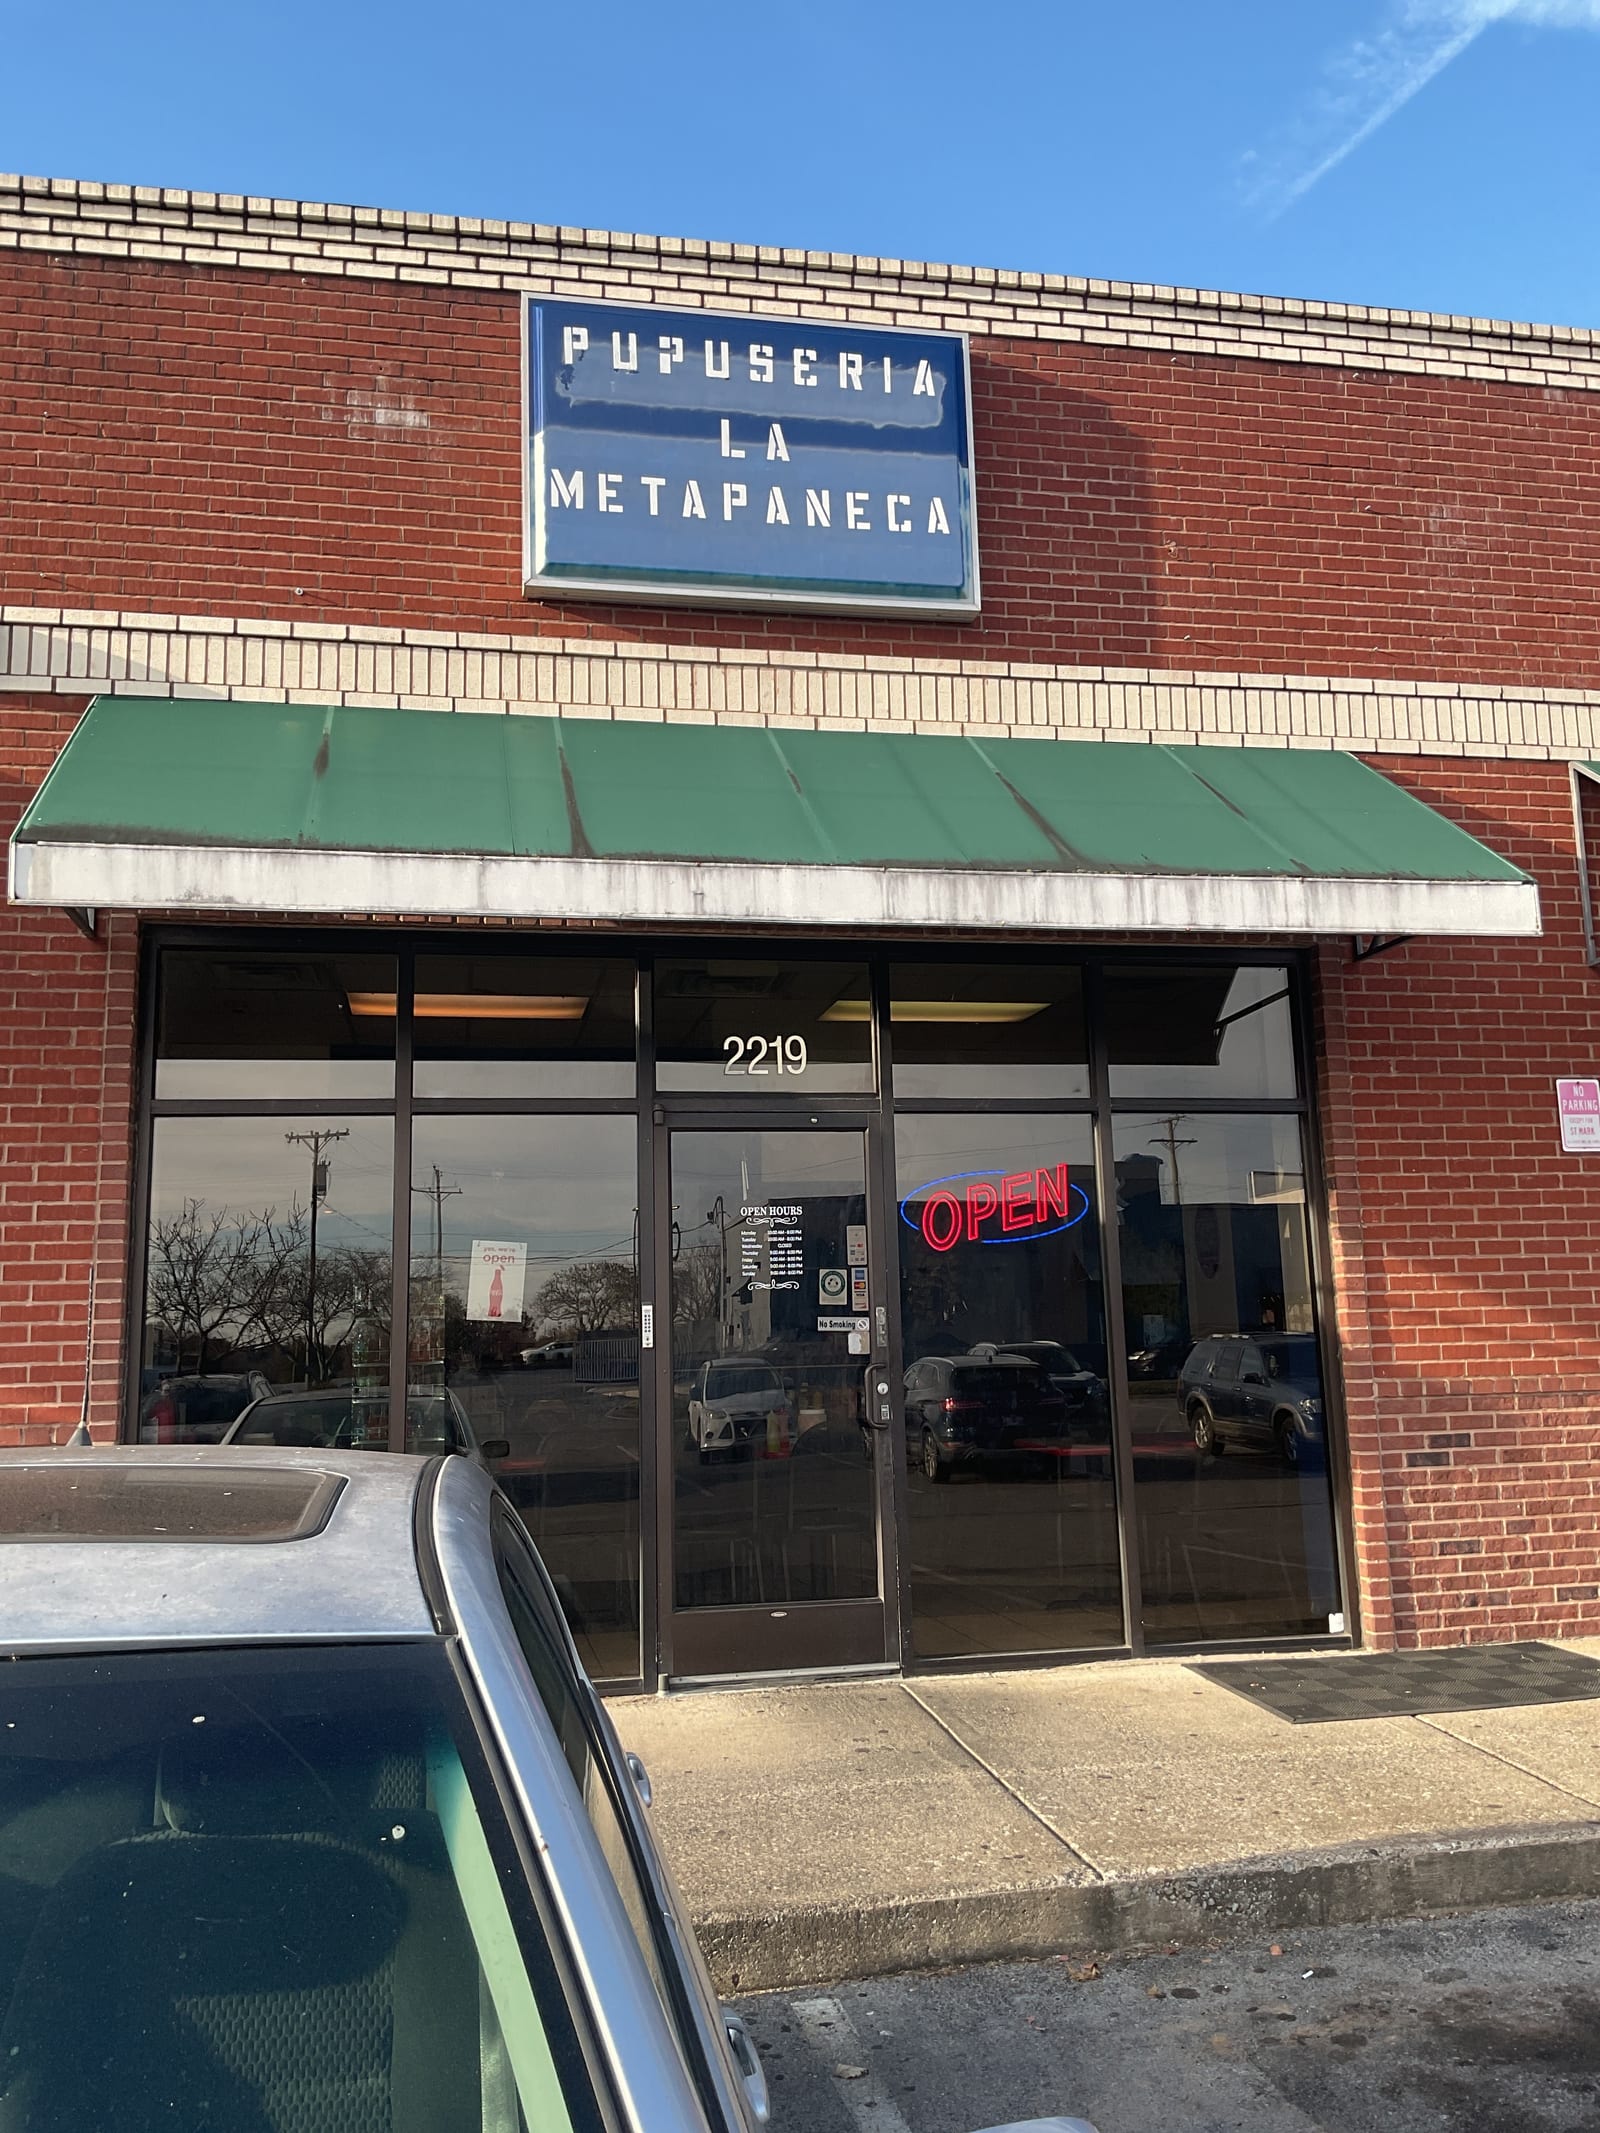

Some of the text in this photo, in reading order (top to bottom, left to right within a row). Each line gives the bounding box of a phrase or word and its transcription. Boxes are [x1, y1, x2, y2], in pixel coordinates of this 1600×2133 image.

[562, 326, 936, 397] PUPUSERIA
[720, 418, 791, 462] LA
[550, 468, 951, 535] METAPANECA
[723, 1035, 807, 1075] 2219
[1572, 1085, 1584, 1097] NO
[1562, 1099, 1598, 1111] PARKING
[740, 1205, 803, 1216] OPEN HOURS
[922, 1163, 1069, 1252] OPEN
[482, 1254, 515, 1265] open
[819, 1319, 856, 1330] No Smoking
